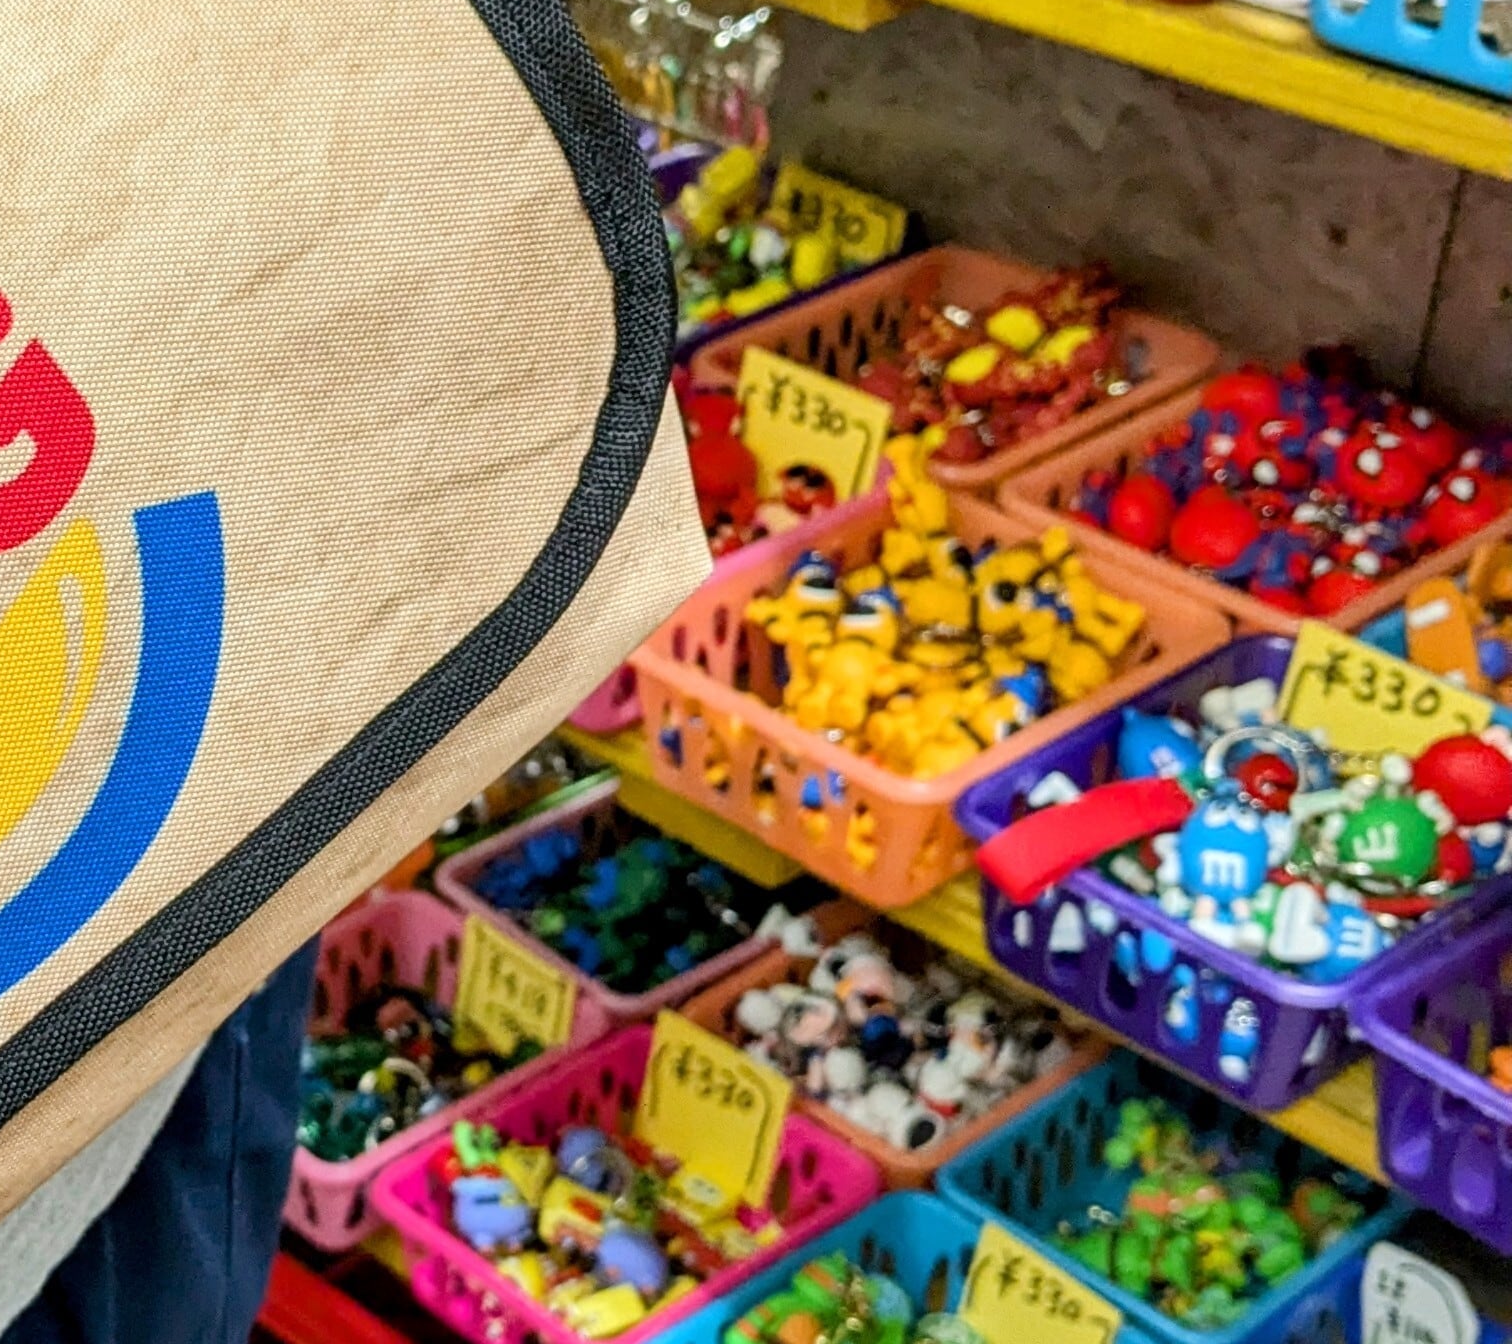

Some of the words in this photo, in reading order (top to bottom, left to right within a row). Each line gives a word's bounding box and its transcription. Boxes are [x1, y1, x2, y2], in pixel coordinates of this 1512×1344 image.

[768, 370, 849, 437] ¥330
[1324, 644, 1442, 717] ¥330
[997, 1252, 1082, 1322] ¥330
